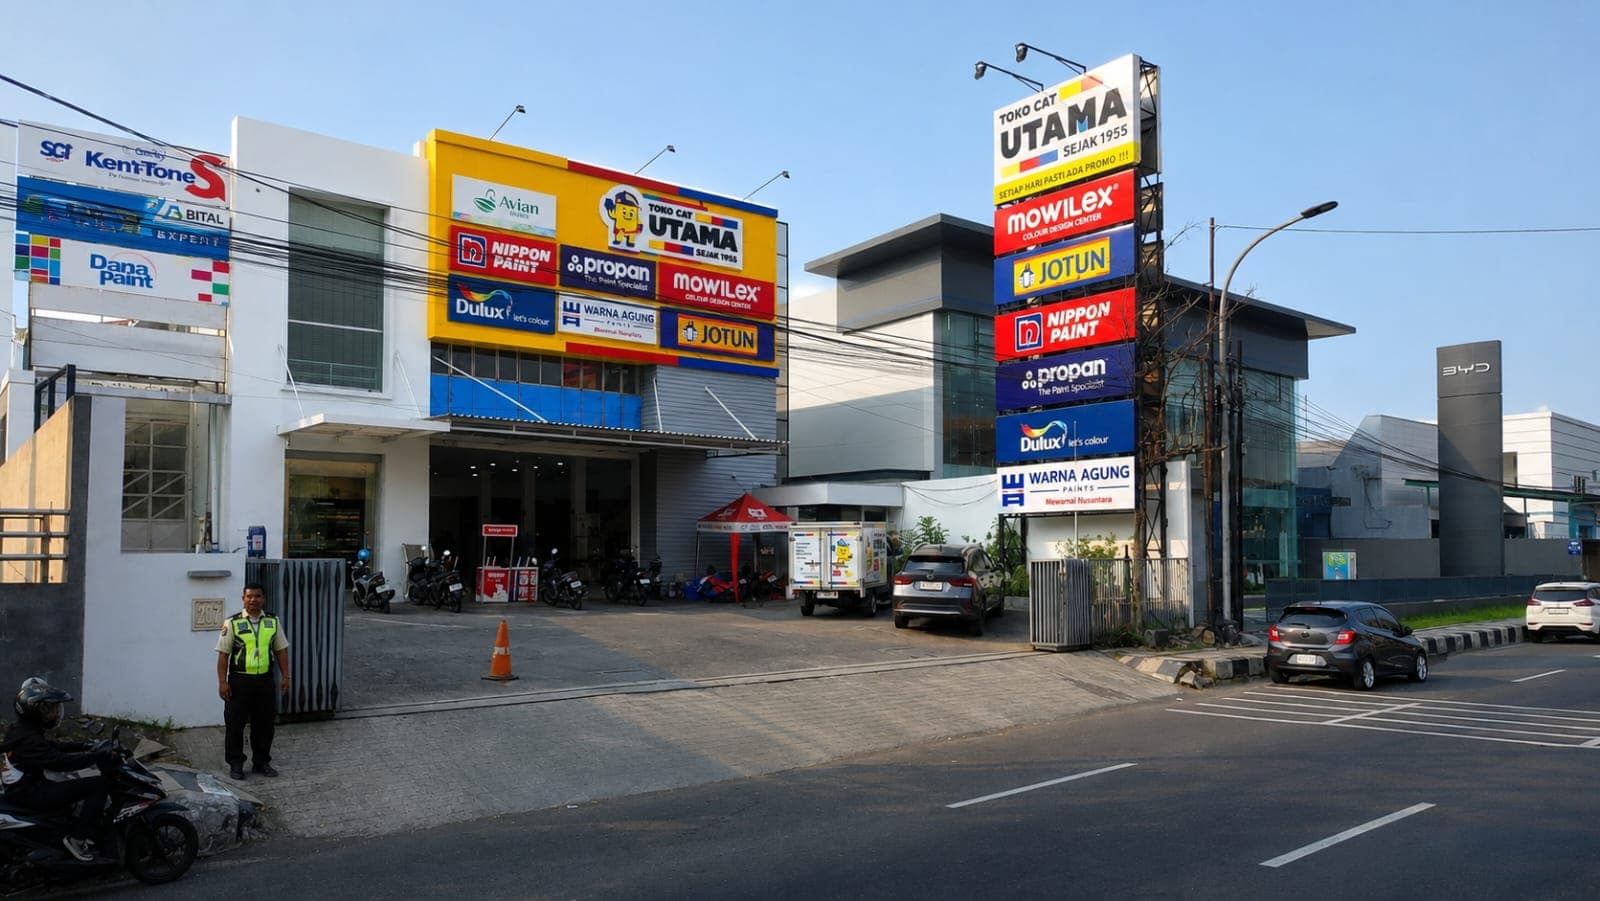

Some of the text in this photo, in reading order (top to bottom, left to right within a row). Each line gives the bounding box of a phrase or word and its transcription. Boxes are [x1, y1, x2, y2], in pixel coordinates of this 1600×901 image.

[1000, 93, 1057, 125] TOKO CAT
[1001, 88, 1127, 159] UTAMA
[1063, 124, 1128, 157] SEJAK 1955
[1000, 185, 1024, 200] SETIAP
[1025, 178, 1043, 193] HARI
[1044, 172, 1065, 188] PASTI
[1066, 166, 1083, 178] ADA
[1085, 156, 1116, 172] PROMO
[500, 196, 539, 215] Avian
[648, 204, 693, 219] TOKO CAT
[187, 209, 224, 224] BITAL
[649, 214, 738, 252] UTAMA
[492, 242, 551, 262] NIPPON
[696, 248, 719, 260] SEJAK
[90, 253, 148, 276] Dana
[493, 255, 539, 273] PAINT
[584, 257, 650, 281] propan
[1040, 248, 1105, 284] JOTUN
[100, 270, 153, 289] Paint
[456, 298, 504, 320] Dulux
[584, 304, 619, 318] WARNA
[622, 311, 654, 324] AGUNG
[1048, 301, 1110, 327] NIPPON
[513, 314, 550, 326] let's colour
[701, 325, 754, 348] JOTUN
[1050, 321, 1099, 343] PAINT
[1038, 359, 1106, 387] propan
[1443, 362, 1490, 376] BYD
[1039, 388, 1051, 396] The
[1052, 386, 1069, 394] Paint
[1021, 437, 1061, 452] Dulux
[1085, 436, 1109, 446] colour
[1030, 465, 1130, 484] WARNA AGUNG
[1062, 485, 1094, 493] PAINTS
